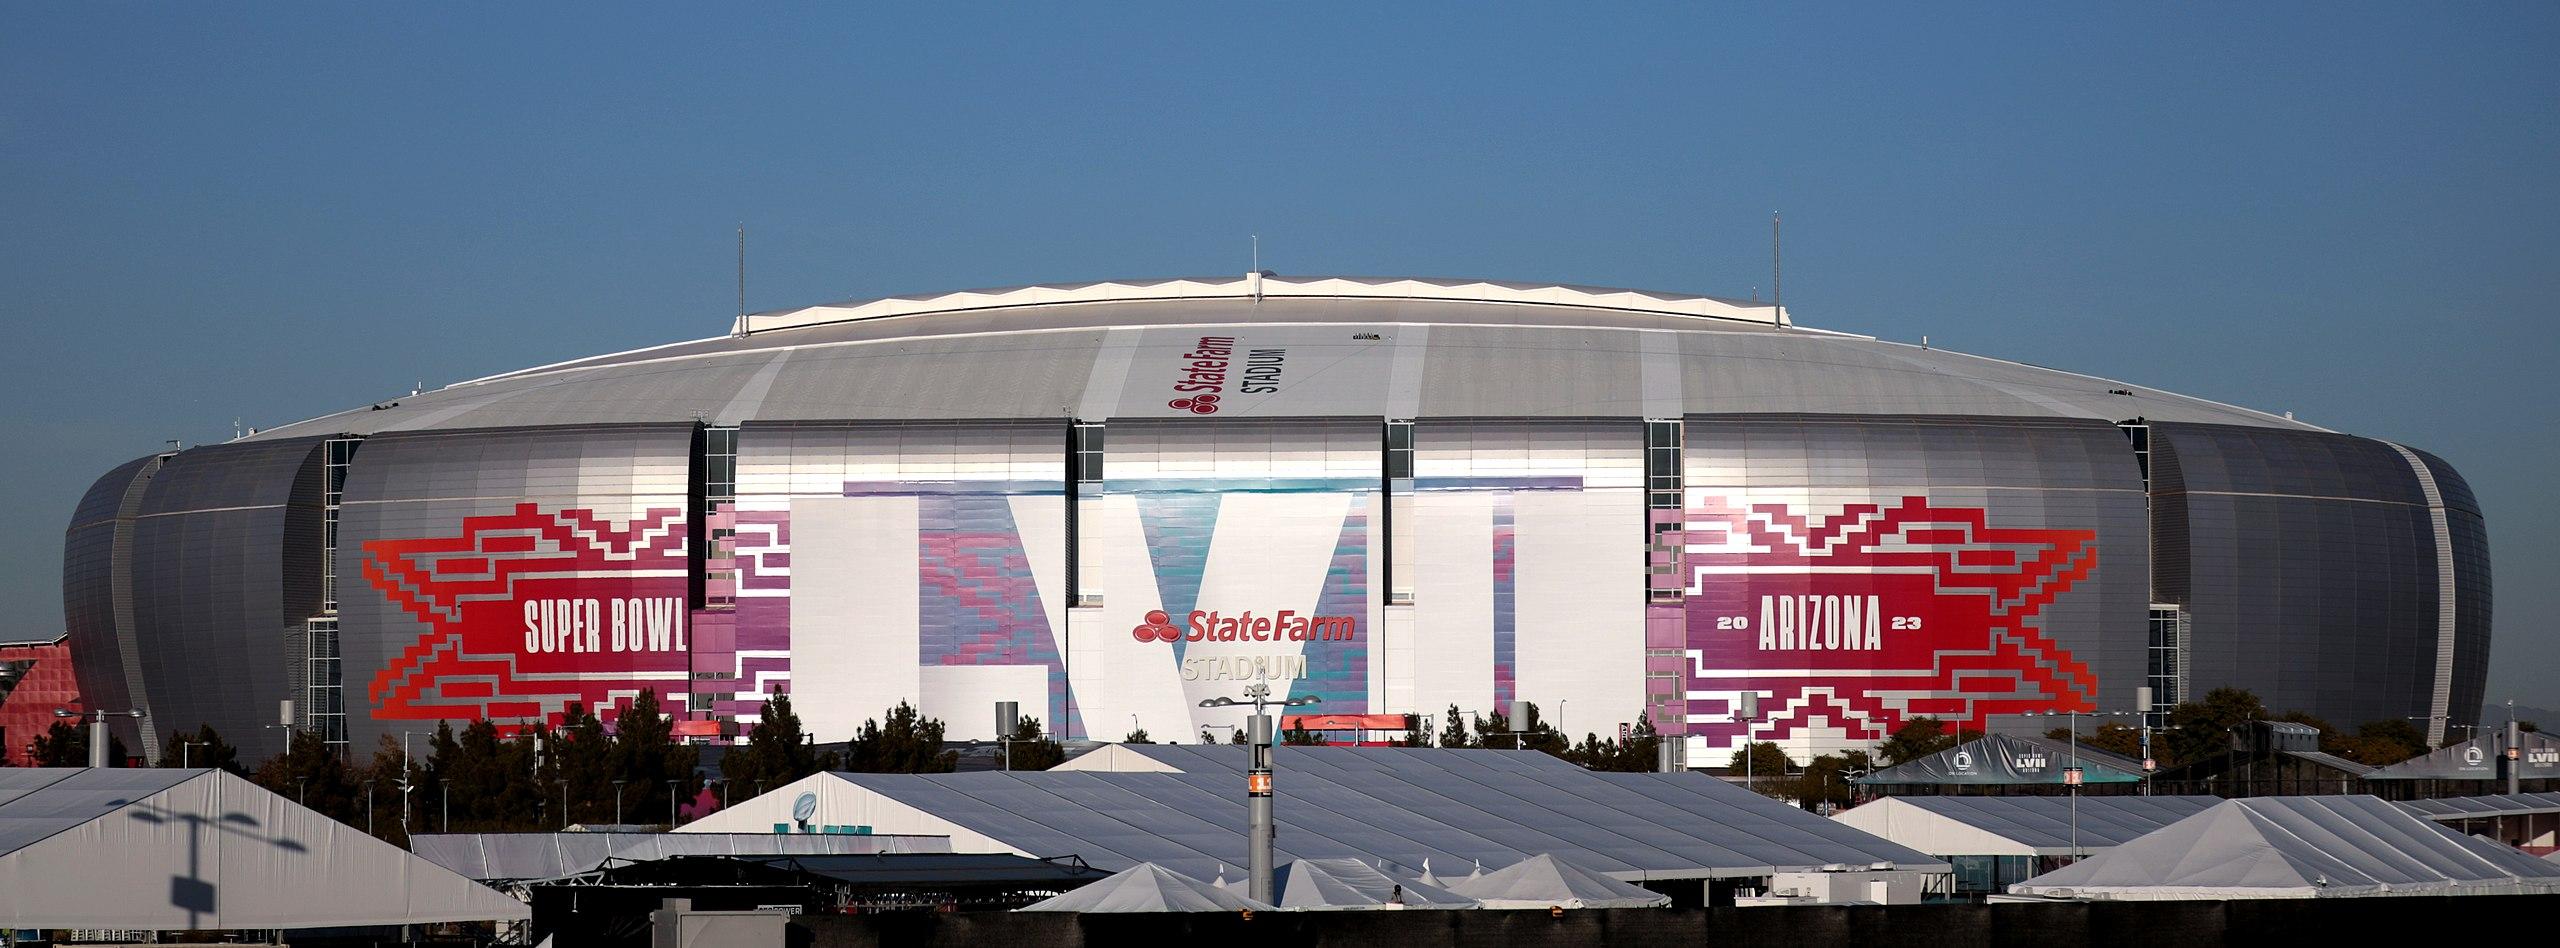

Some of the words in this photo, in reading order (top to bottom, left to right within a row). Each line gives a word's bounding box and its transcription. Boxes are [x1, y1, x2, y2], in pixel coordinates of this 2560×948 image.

[1240, 349, 1286, 393] STADIUM
[524, 598, 600, 654] SUPER
[611, 597, 687, 652] BOWL
[1716, 616, 1749, 630] 20
[1758, 595, 1882, 650] ARIZONA
[1891, 616, 1922, 630] 23
[1183, 655, 1308, 681] STADIUM
[2016, 758, 2046, 768] LVII
[2528, 753, 2559, 763] LVII
